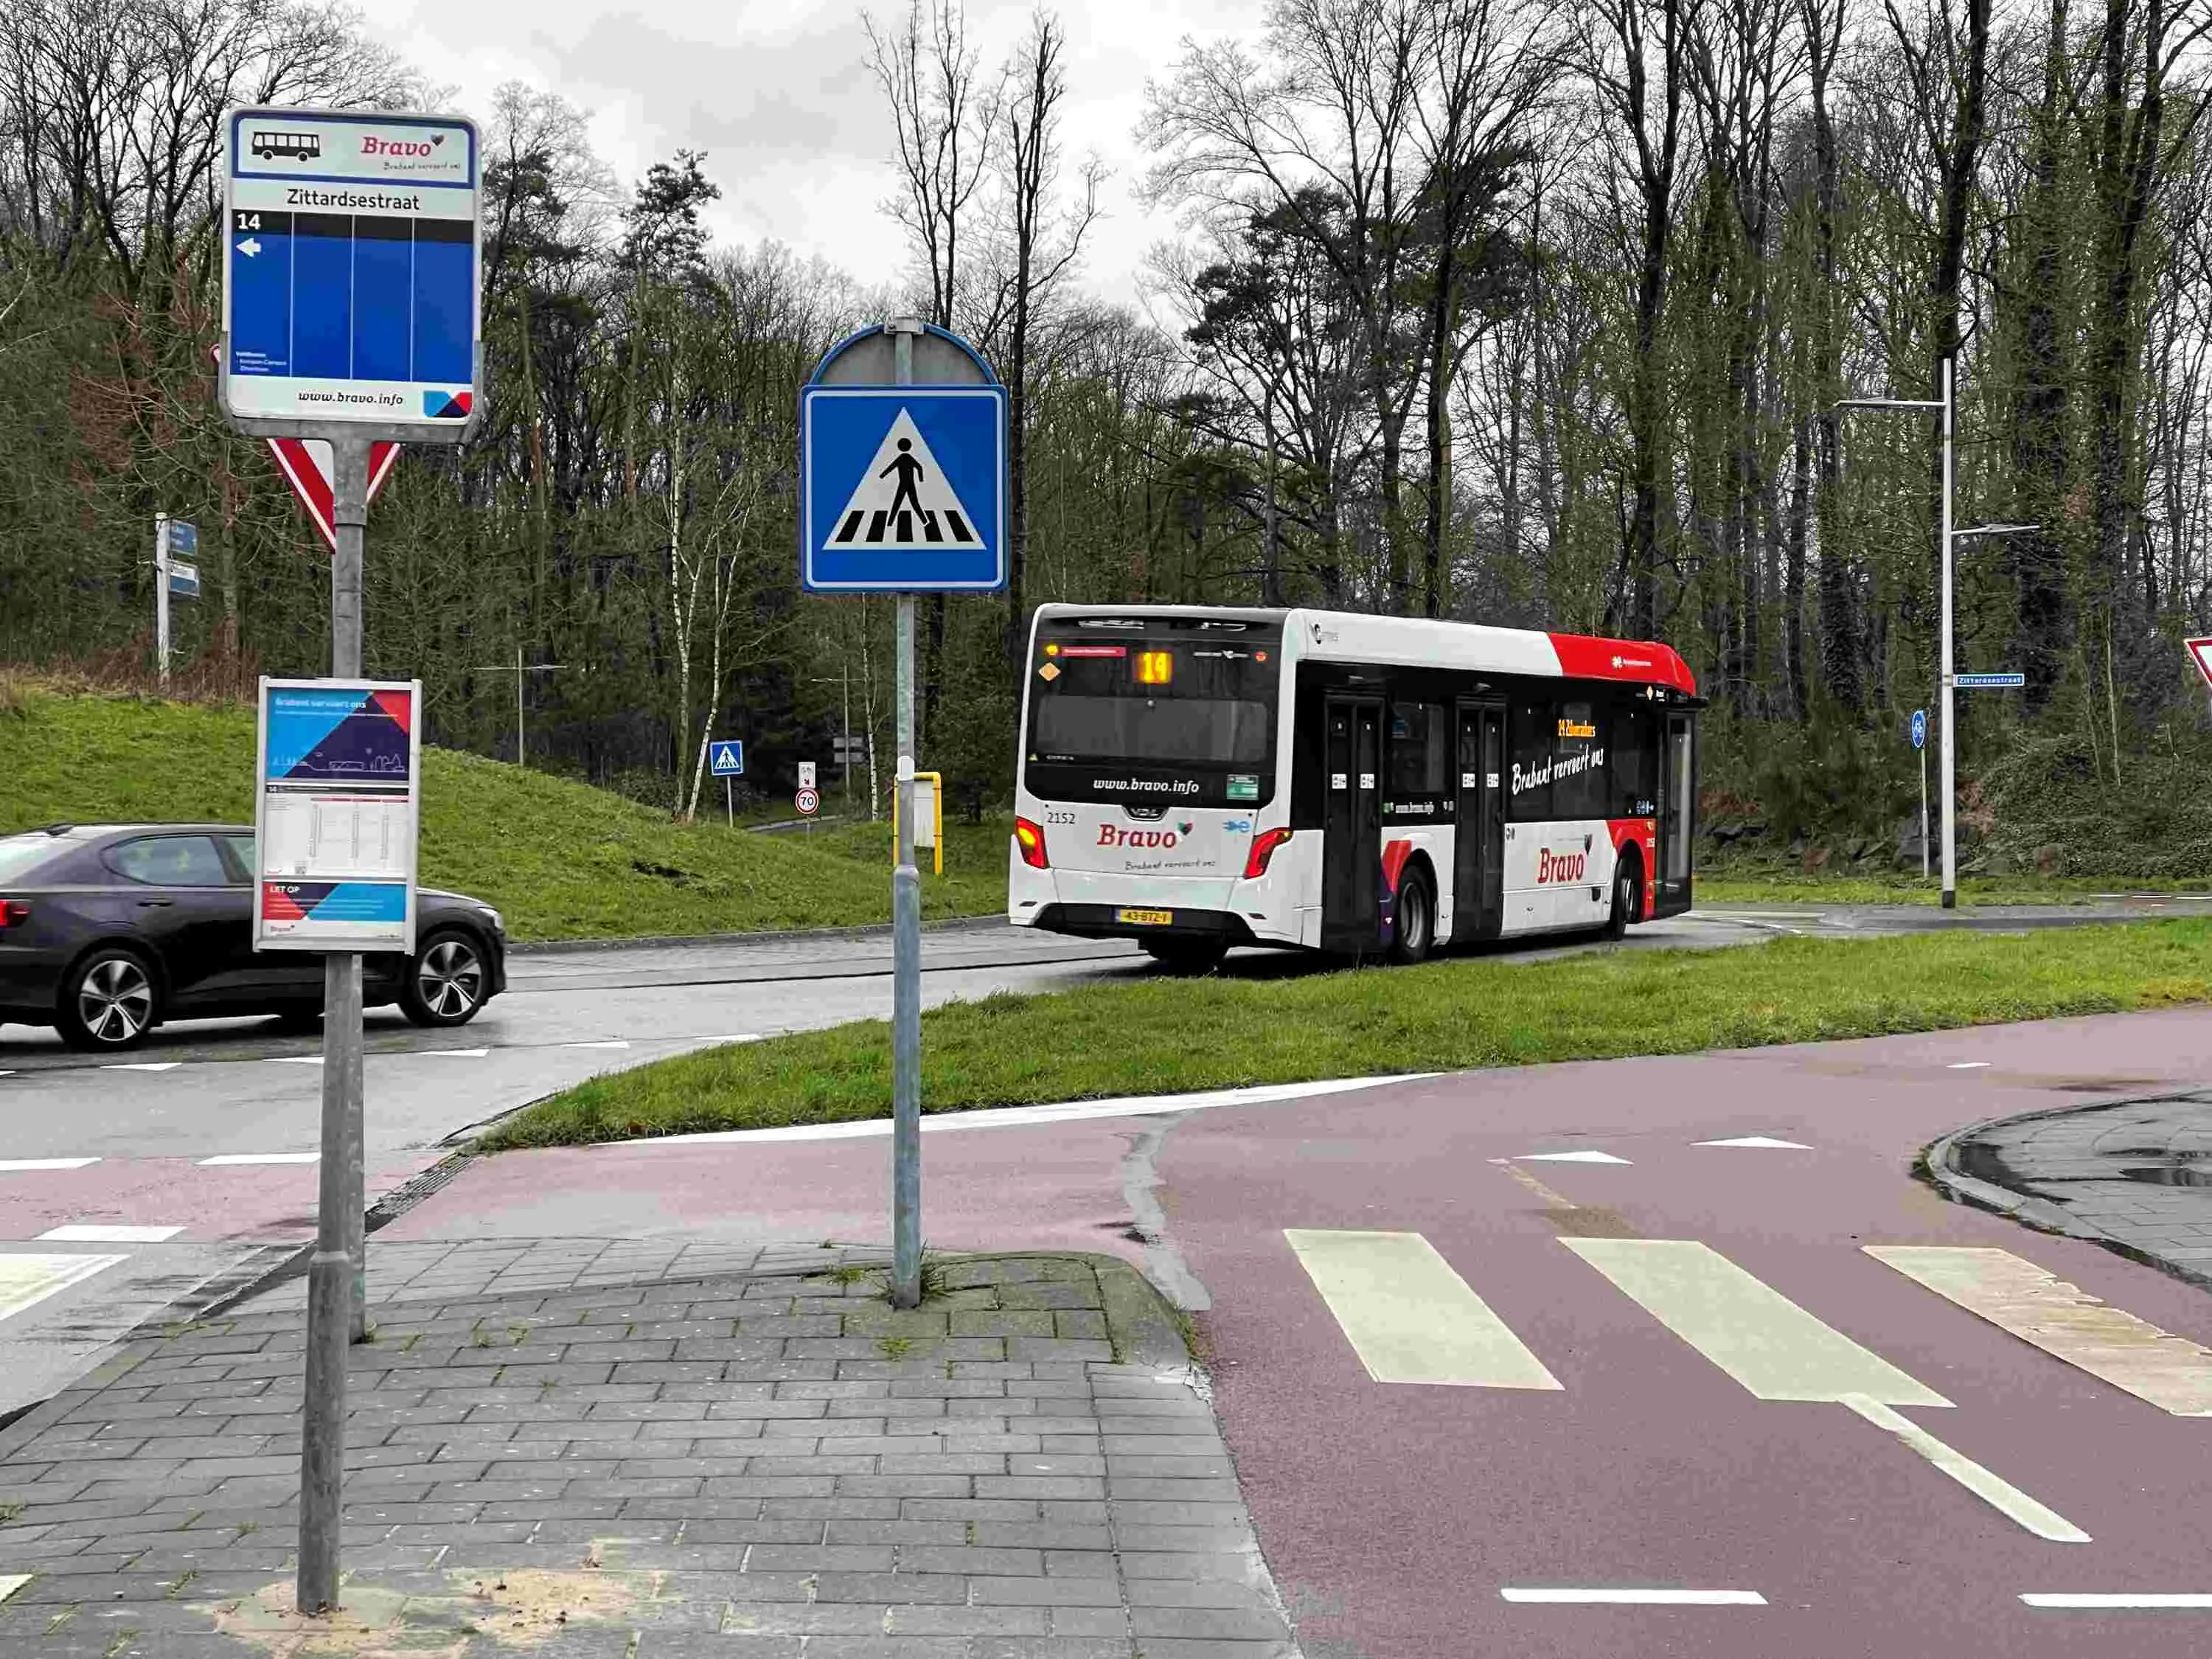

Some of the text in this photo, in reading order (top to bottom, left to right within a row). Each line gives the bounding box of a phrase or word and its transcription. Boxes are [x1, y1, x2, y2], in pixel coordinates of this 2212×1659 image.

[360, 136, 431, 157] Bravo
[286, 188, 420, 211] Zittardsestraat
[237, 213, 261, 230] 14
[298, 392, 404, 406] www.bravo.info
[1512, 742, 1604, 796] Brabant vervoert ons
[1093, 778, 1200, 795] www.bravo.info
[801, 796, 814, 806] 70
[1047, 812, 1076, 824] 2152
[1096, 824, 1178, 849] Bravo
[1537, 847, 1585, 883] Bravo
